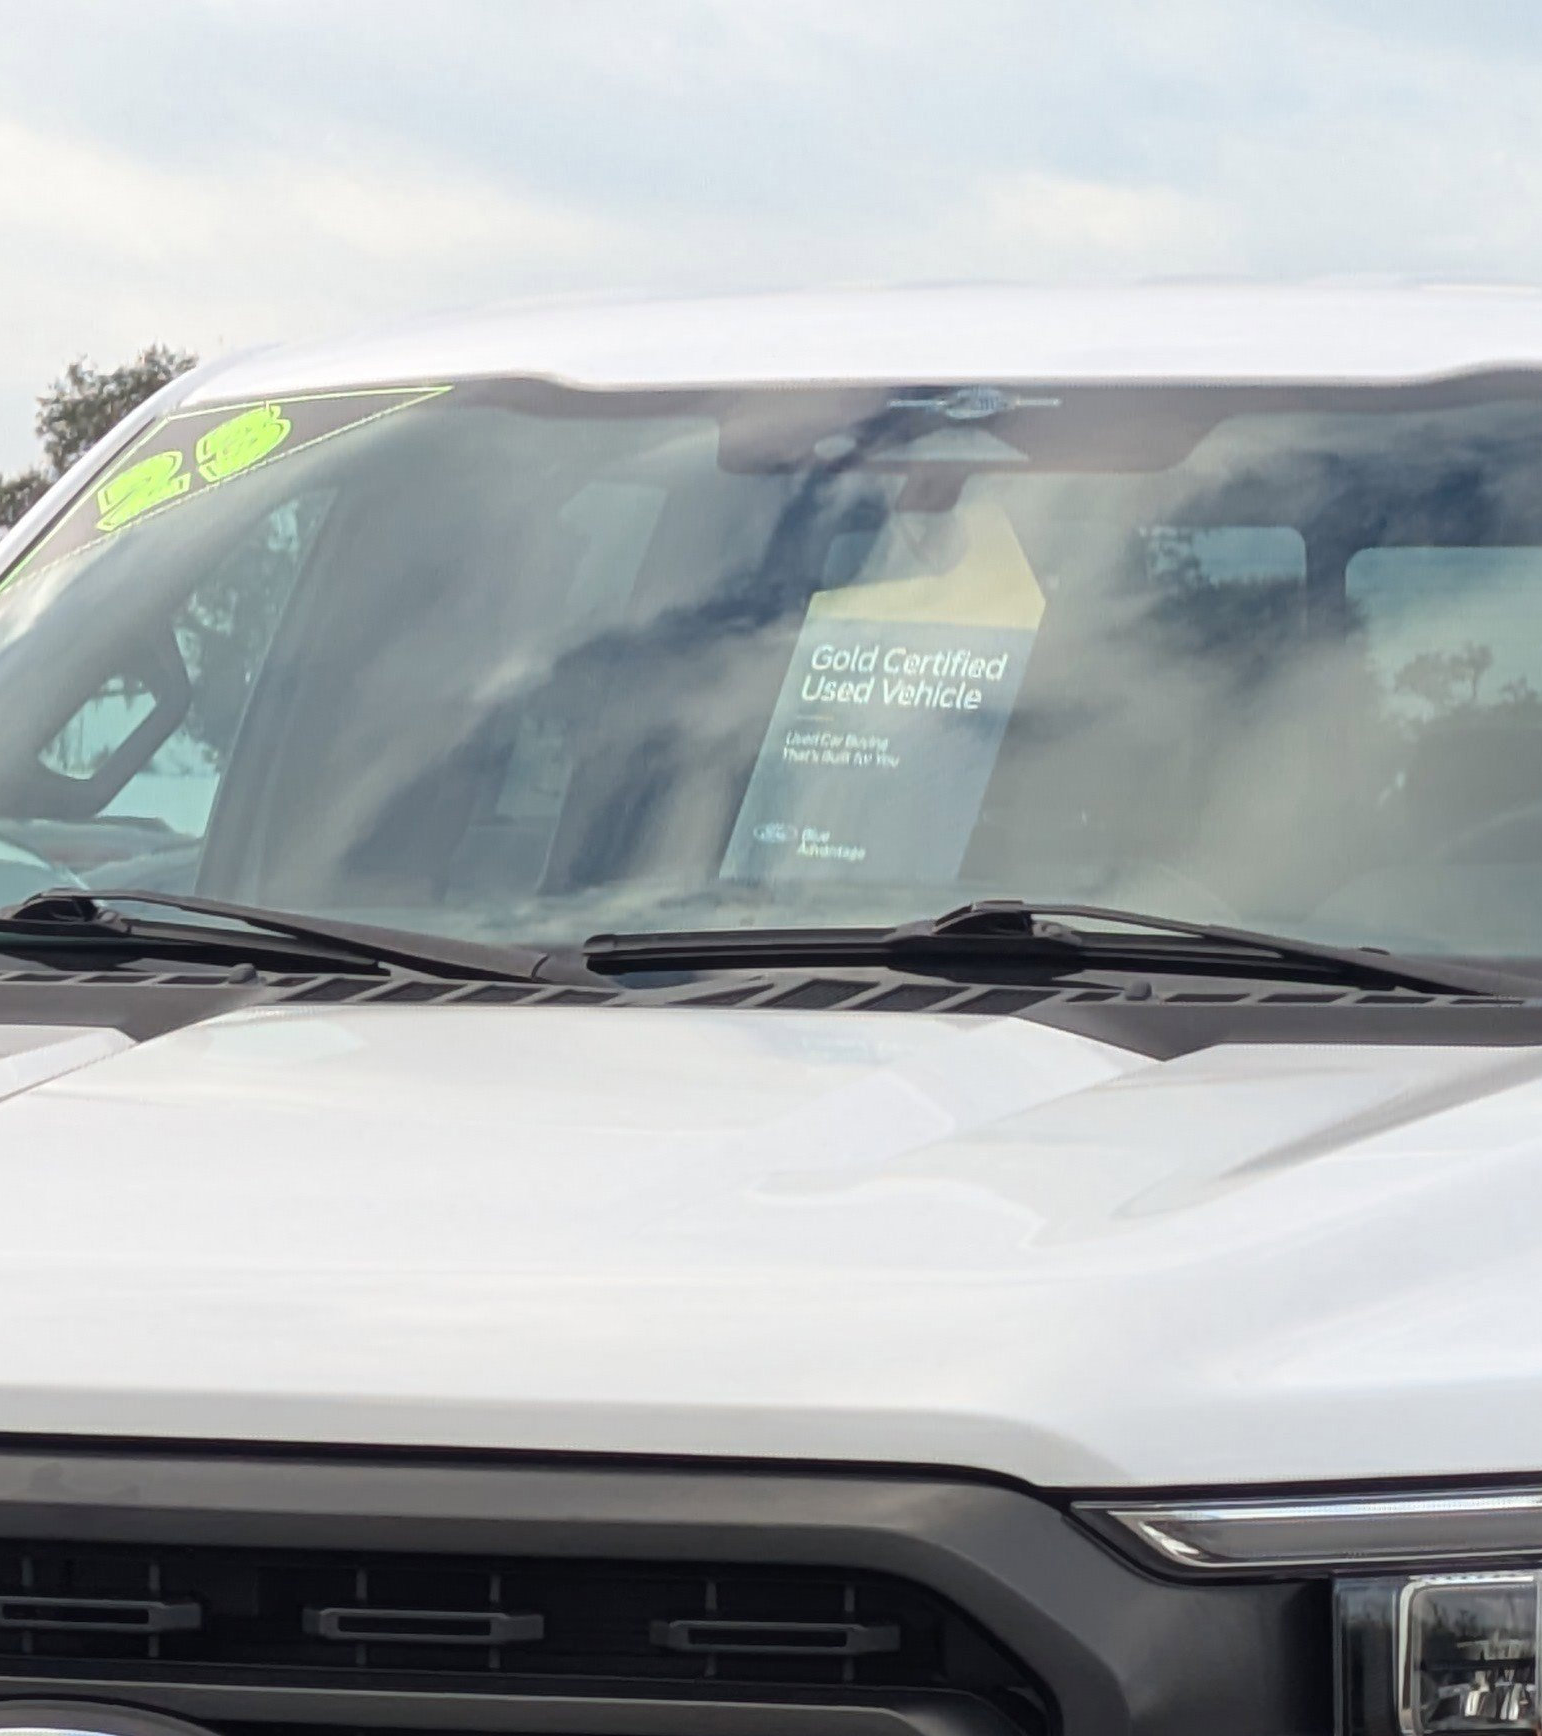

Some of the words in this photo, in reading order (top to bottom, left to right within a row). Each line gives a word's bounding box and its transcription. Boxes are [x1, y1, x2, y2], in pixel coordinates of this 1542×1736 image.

[811, 644, 880, 672] Gold
[883, 647, 1008, 680] Certified
[801, 675, 875, 703] Used
[882, 677, 983, 709] Vehicle
